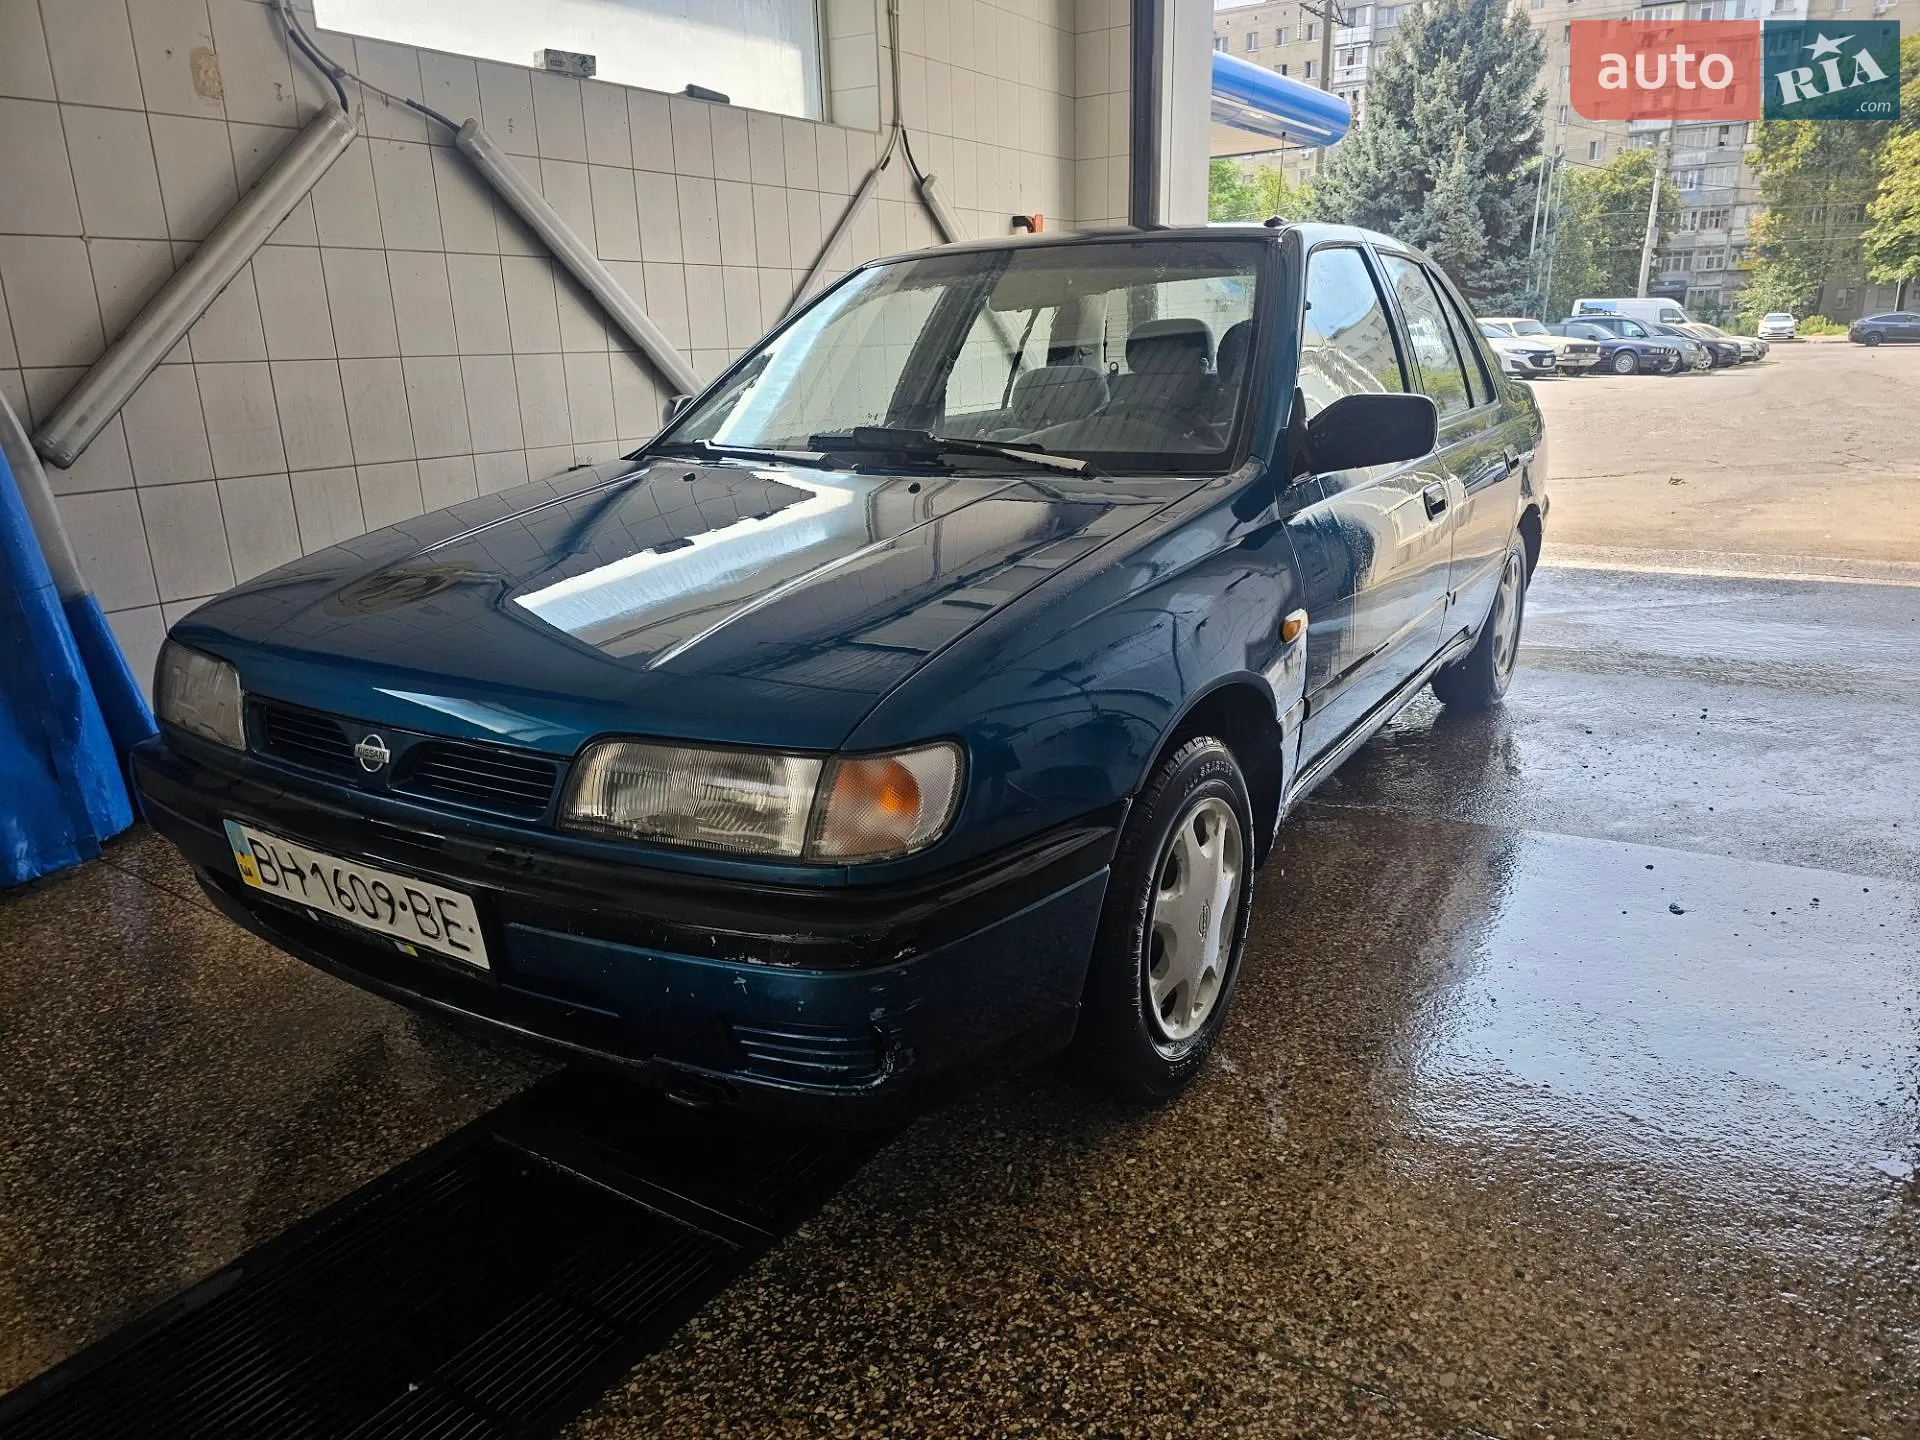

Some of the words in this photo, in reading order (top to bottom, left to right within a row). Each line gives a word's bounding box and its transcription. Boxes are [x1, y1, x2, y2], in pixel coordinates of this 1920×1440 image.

[357, 747, 386, 761] NISSAN
[247, 836, 307, 896] BH
[310, 862, 395, 924] 1609
[403, 886, 471, 952] BE
